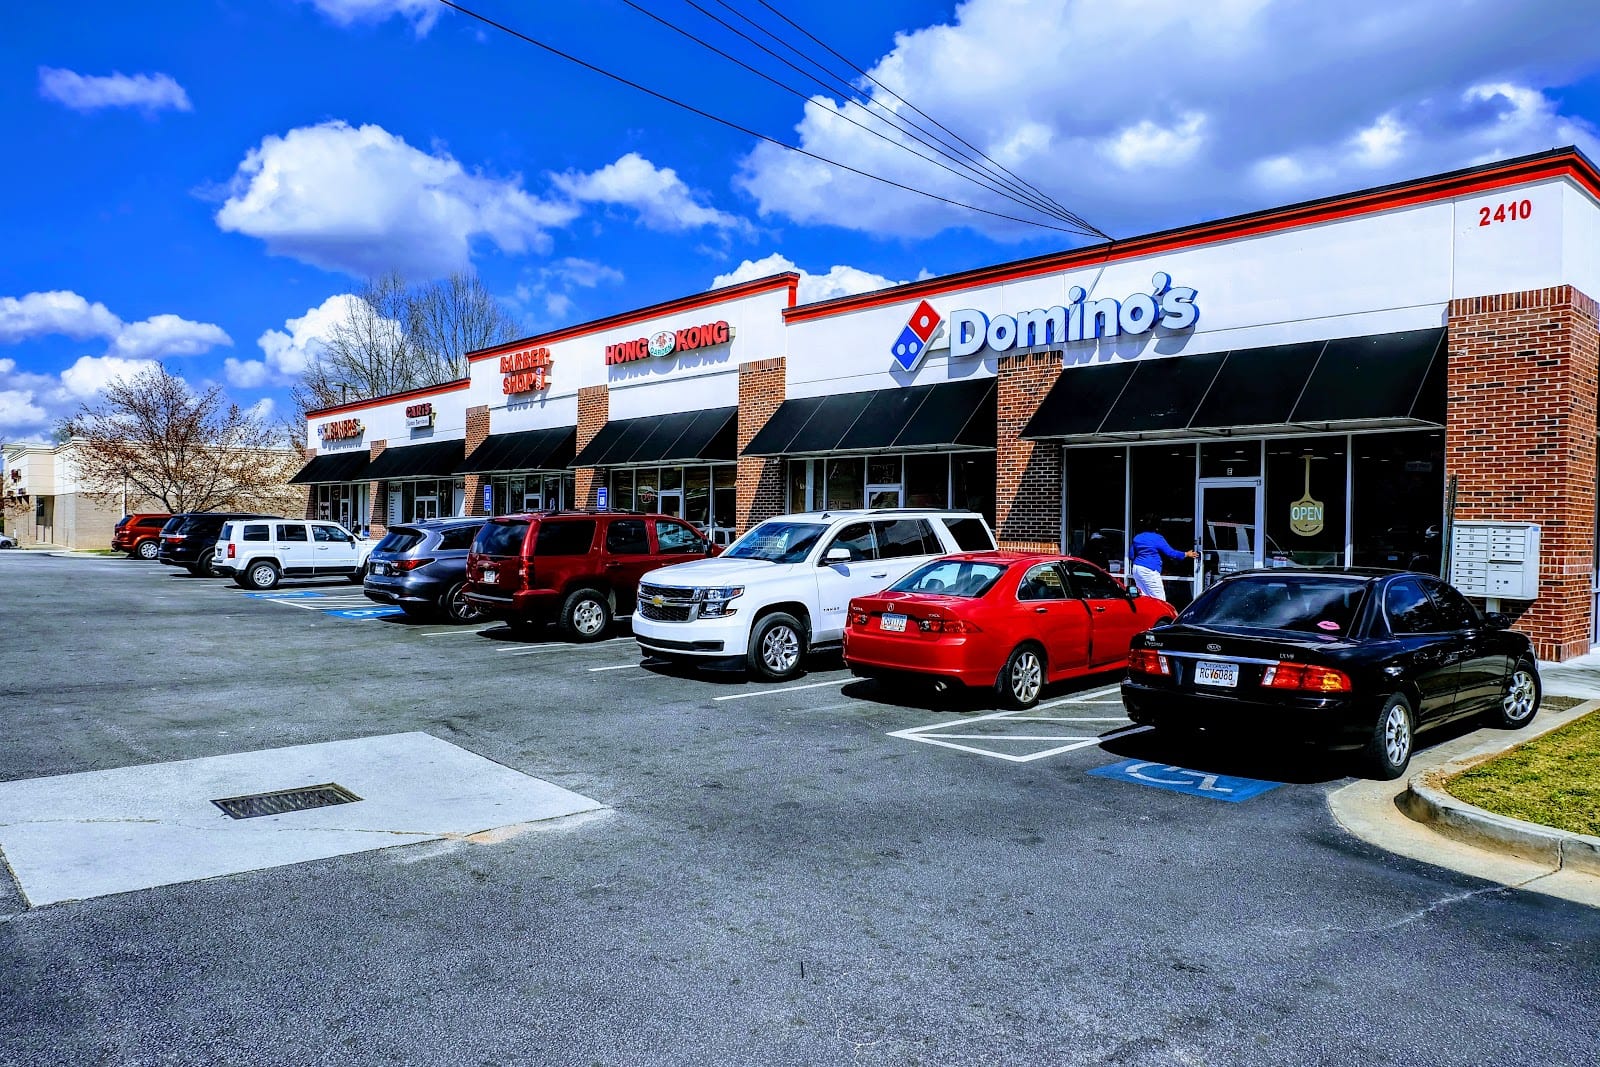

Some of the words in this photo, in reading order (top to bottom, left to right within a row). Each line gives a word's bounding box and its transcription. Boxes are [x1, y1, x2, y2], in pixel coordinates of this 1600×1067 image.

[1479, 199, 1532, 227] 2410
[950, 271, 1199, 358] Domino's
[605, 337, 649, 366] HONG
[675, 320, 730, 352] KONG
[500, 347, 550, 373] BARBER
[503, 372, 537, 394] SHOP
[1291, 506, 1323, 521] OPEN
